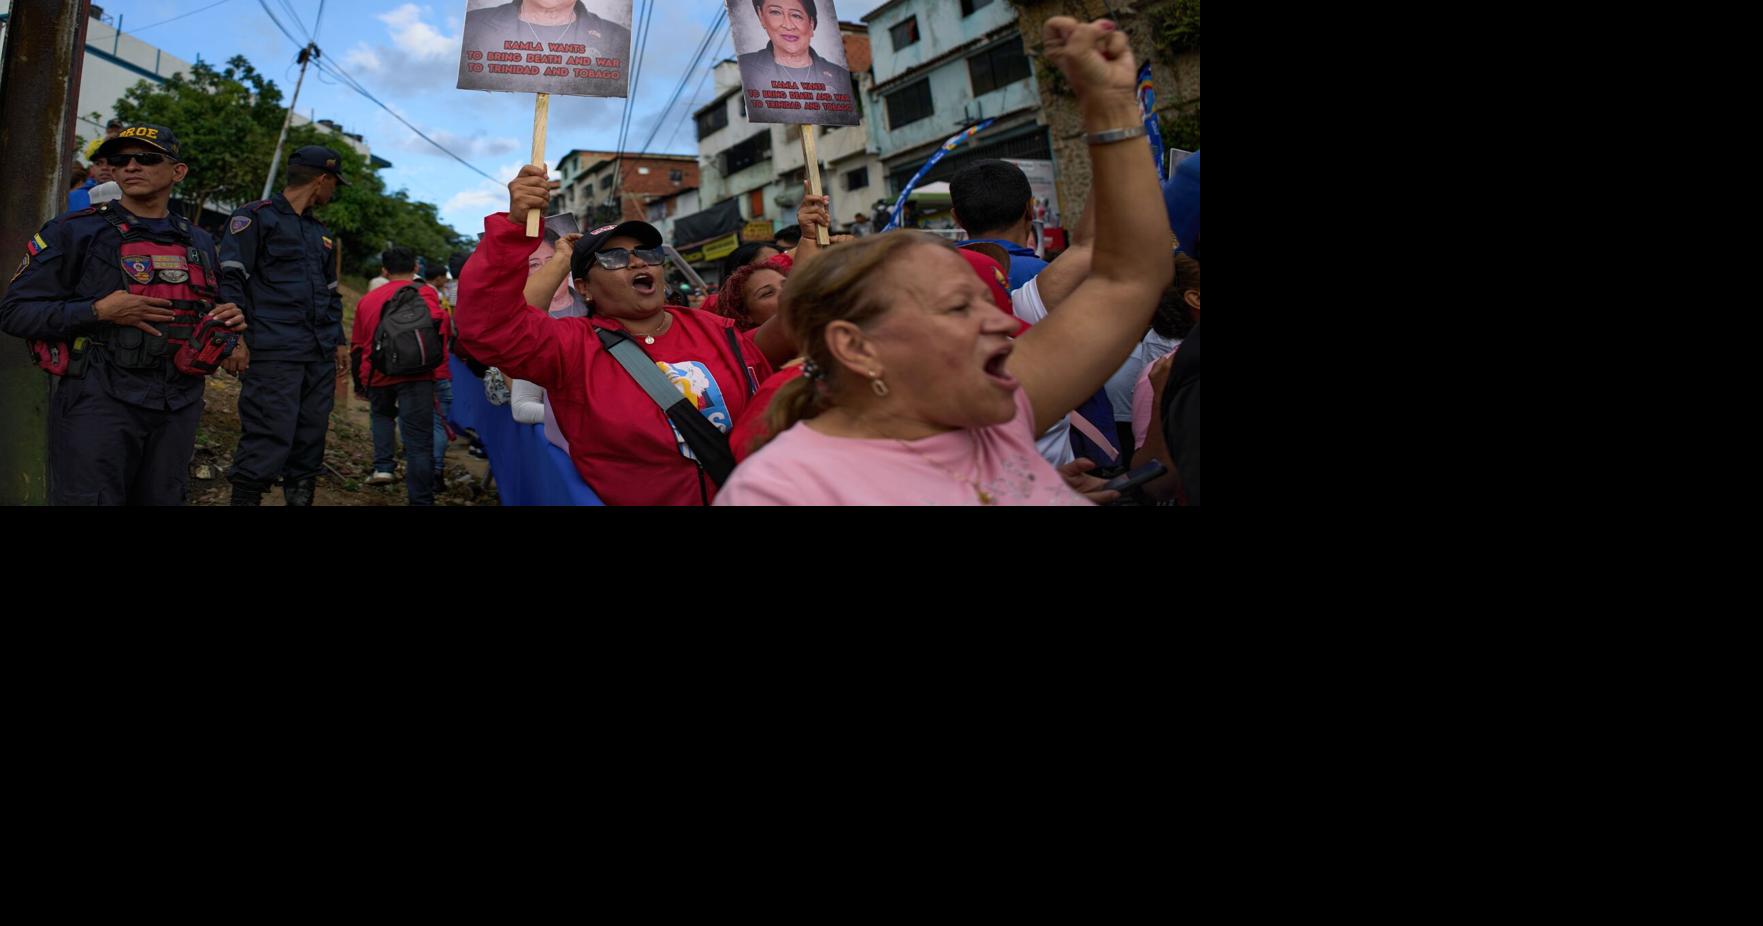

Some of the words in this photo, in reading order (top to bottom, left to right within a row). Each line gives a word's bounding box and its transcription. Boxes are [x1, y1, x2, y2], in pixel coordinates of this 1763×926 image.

[503, 40, 544, 51] KAMLA
[548, 42, 586, 54] WANTS
[467, 50, 483, 61] TO
[486, 51, 522, 63] BRING
[526, 53, 562, 64] DEATH
[566, 55, 591, 66] AND
[595, 57, 620, 68] WAR
[467, 63, 483, 73] TO
[488, 63, 540, 75] TRINIDAD
[543, 66, 569, 77] AND
[573, 68, 620, 80] TOBAGO
